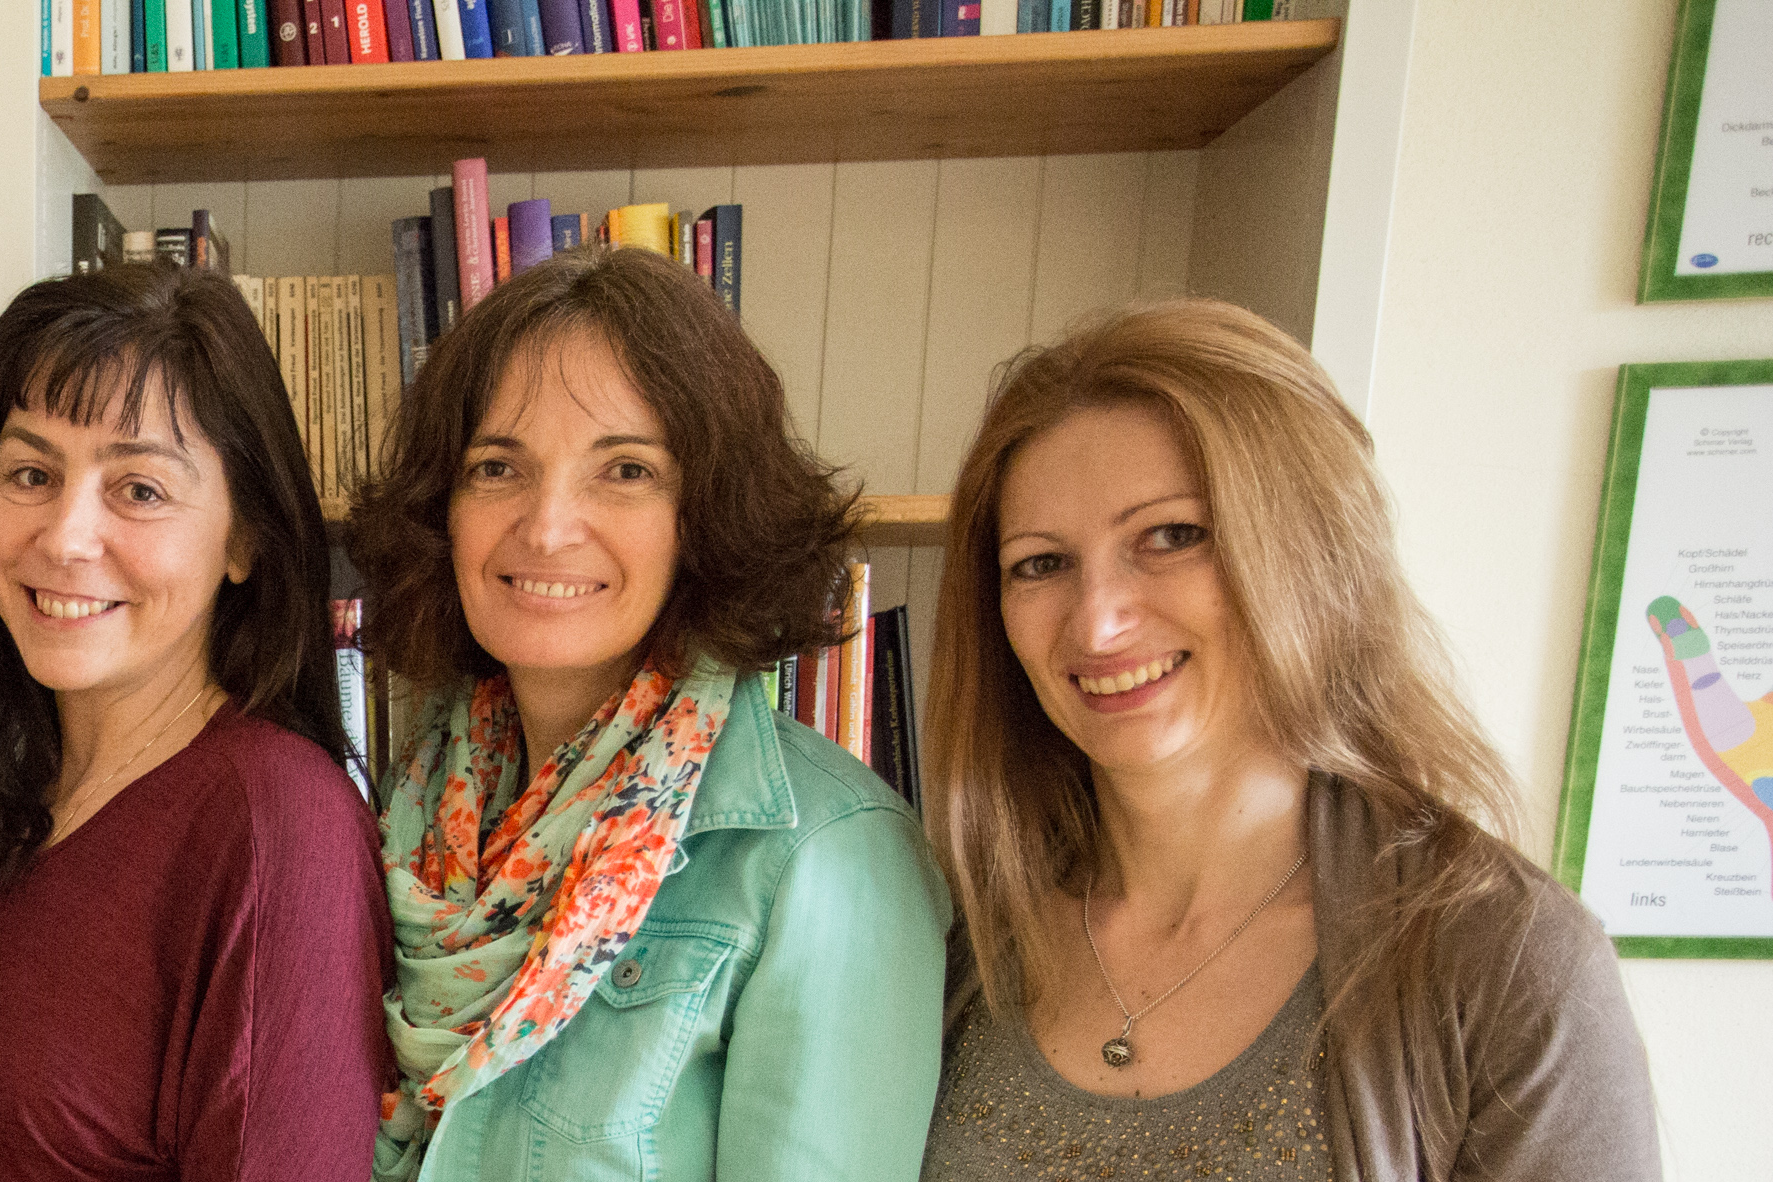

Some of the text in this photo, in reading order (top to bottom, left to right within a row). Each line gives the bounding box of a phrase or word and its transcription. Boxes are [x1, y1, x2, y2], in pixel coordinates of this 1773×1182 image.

[331, 15, 340, 28] 1
[309, 22, 318, 35] 2
[356, 3, 372, 55] HEROLD
[722, 241, 734, 285] Zellen
[1712, 427, 1749, 438] Copyright
[1678, 548, 1748, 560] Kopf/Schädel
[1688, 563, 1735, 575] Großhirn
[1713, 593, 1753, 605] Schläfe
[783, 662, 793, 689] Ulrich
[1632, 665, 1659, 676] Nase
[1736, 670, 1762, 681] Herz
[338, 653, 355, 722] Bäume
[1634, 680, 1665, 689] Kiefer
[1639, 694, 1665, 704] Hals-
[1642, 709, 1672, 719] Brust-
[1623, 724, 1682, 735] Wirbelsäule
[1660, 752, 1687, 762] darm
[1669, 769, 1706, 781] Magen
[1620, 783, 1722, 796] Bauchspeicheldrüse
[1659, 798, 1725, 809] Nebennieren
[1686, 813, 1720, 823] Nieren
[1681, 827, 1730, 838] Harnleiter
[1709, 842, 1739, 852] Blase
[1619, 857, 1713, 868] Lendenwirbelsäule
[1705, 872, 1757, 882] Kreuzbein
[1713, 886, 1762, 897] Steißbein
[1630, 892, 1667, 907] links
